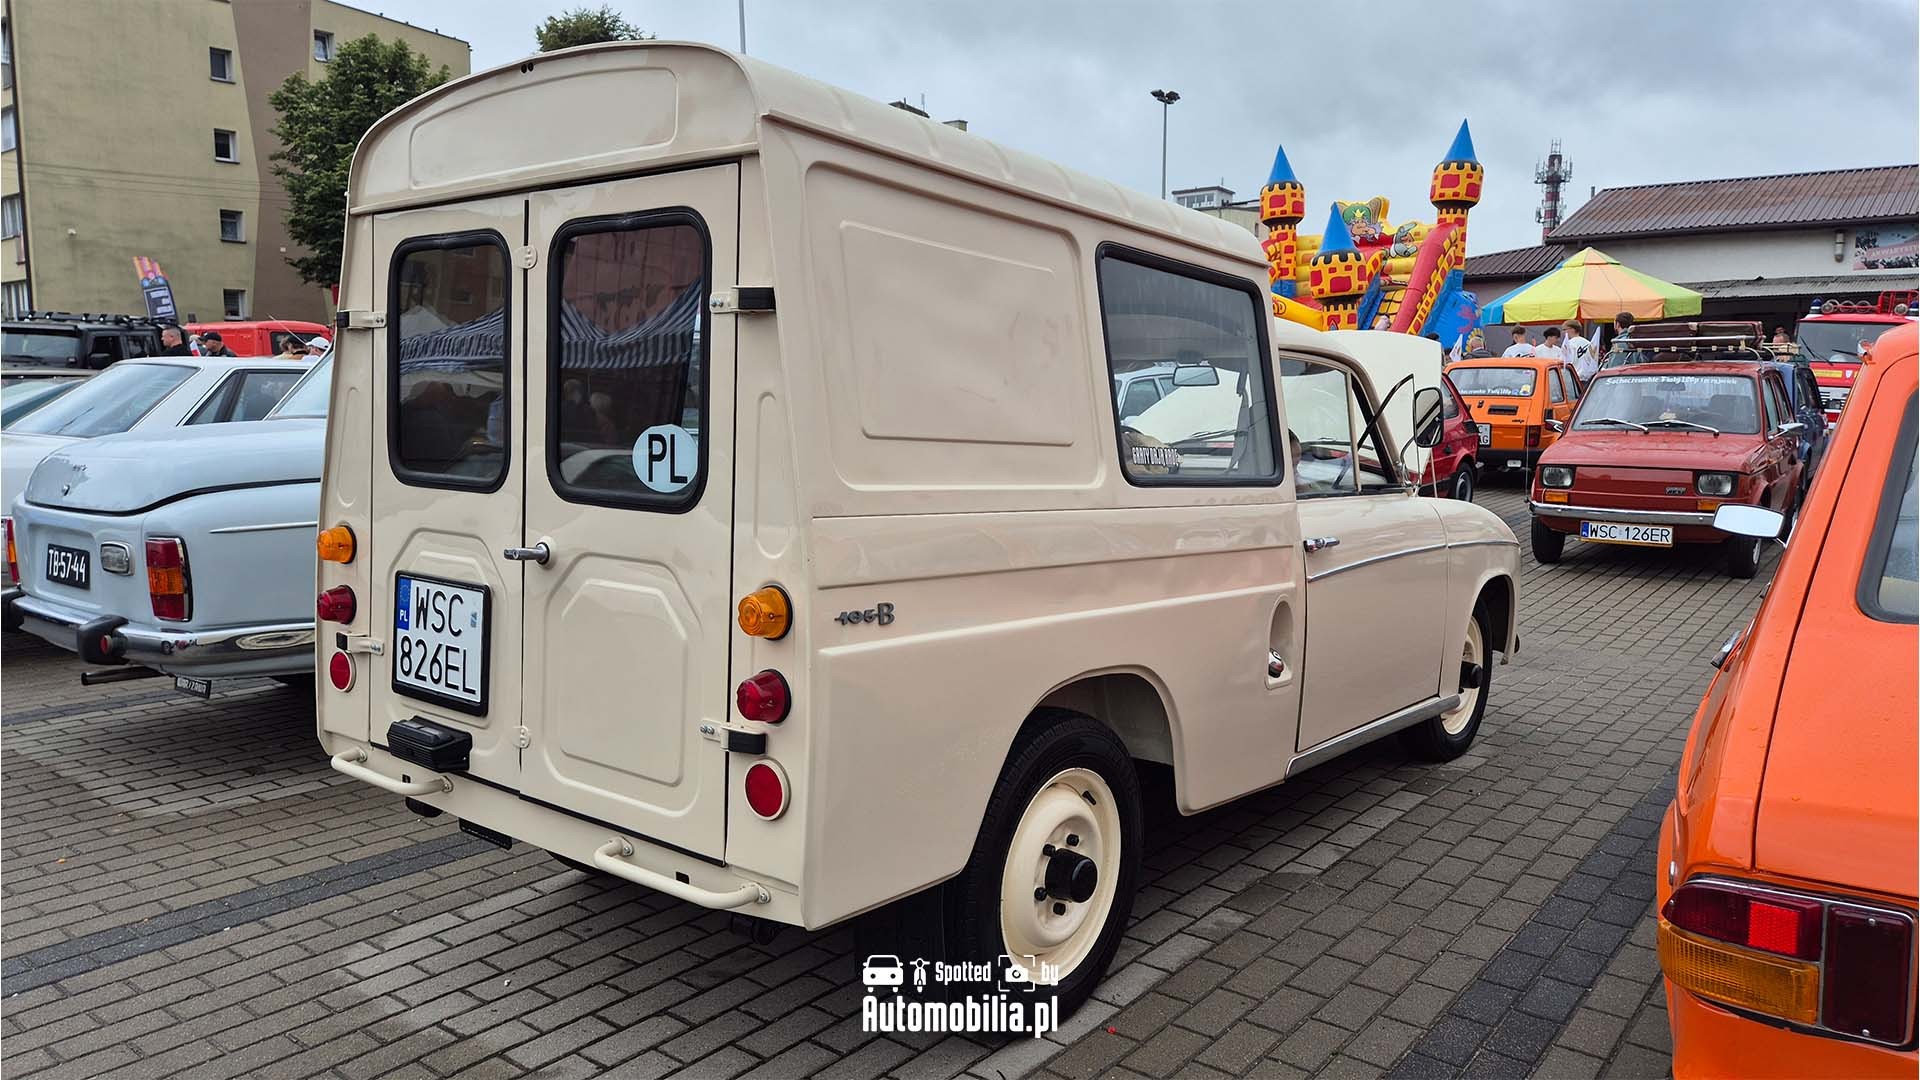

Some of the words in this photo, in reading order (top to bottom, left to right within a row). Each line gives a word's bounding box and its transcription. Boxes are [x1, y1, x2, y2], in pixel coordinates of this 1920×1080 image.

[648, 433, 688, 484] PL
[1590, 524, 1618, 539] WSC
[1624, 526, 1671, 543] 126ER
[399, 609, 409, 622] PL
[415, 586, 464, 637] WSC
[400, 635, 478, 695] 826EL
